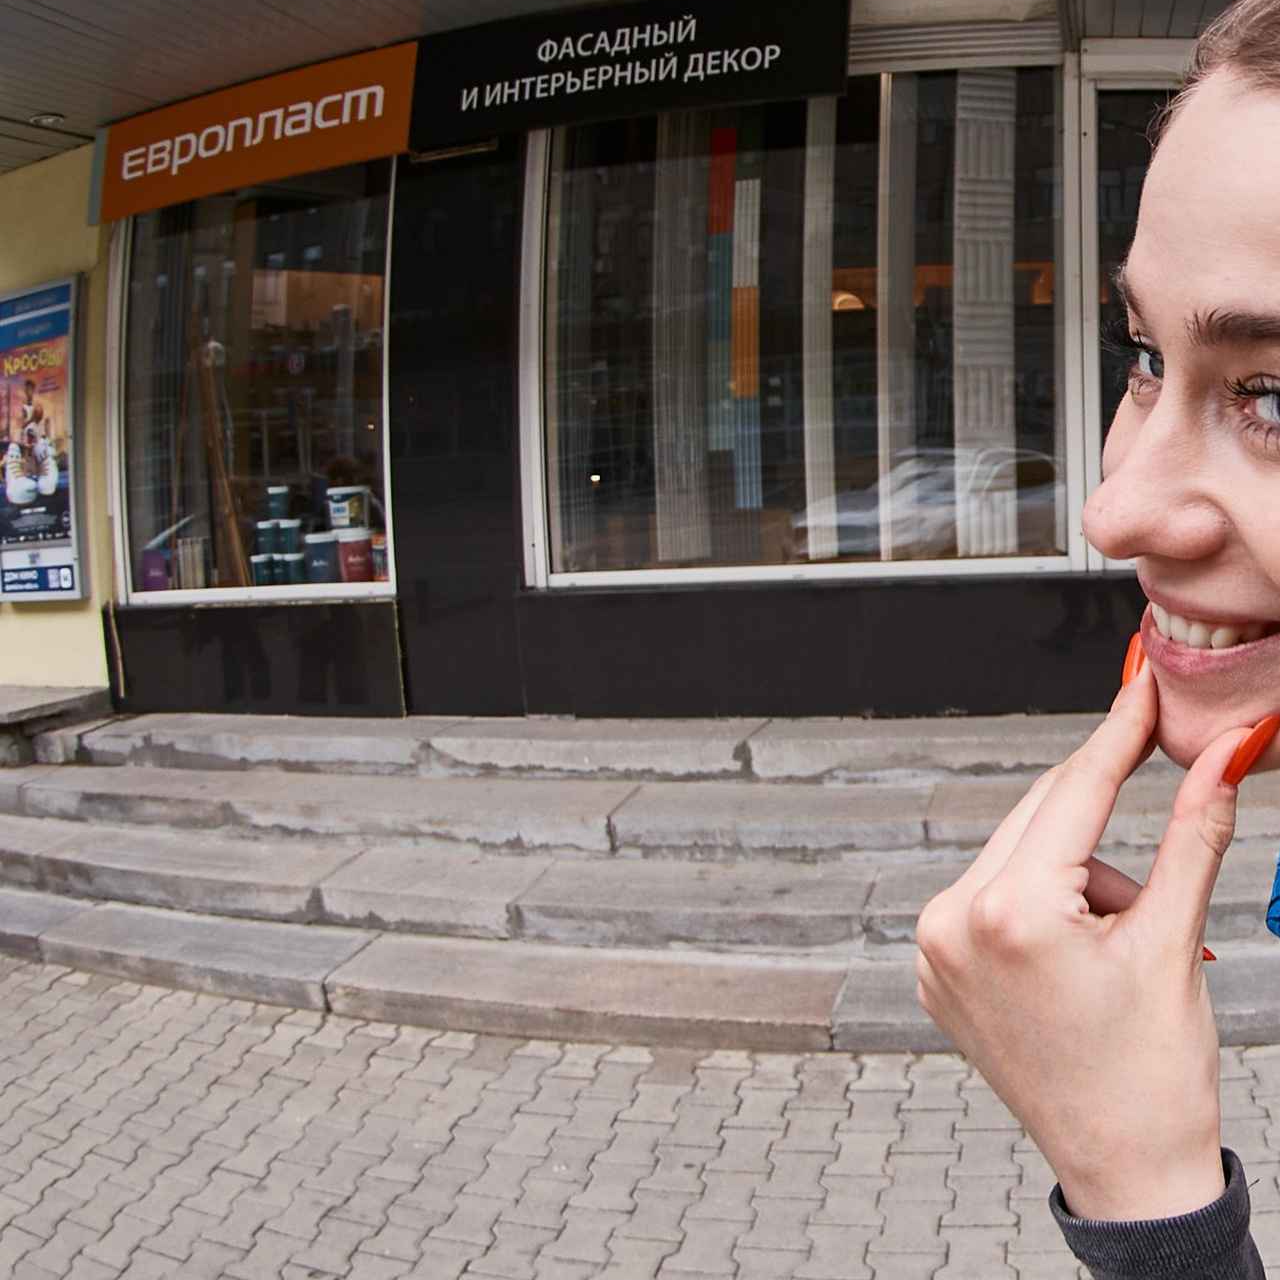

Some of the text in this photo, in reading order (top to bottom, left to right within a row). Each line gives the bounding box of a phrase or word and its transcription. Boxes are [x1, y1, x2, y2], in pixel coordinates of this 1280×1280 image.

[537, 14, 697, 63] ФАСАДНЫЙ
[461, 44, 781, 112] И ИНТЕРЬЕРНЫЙ ДЕКОР
